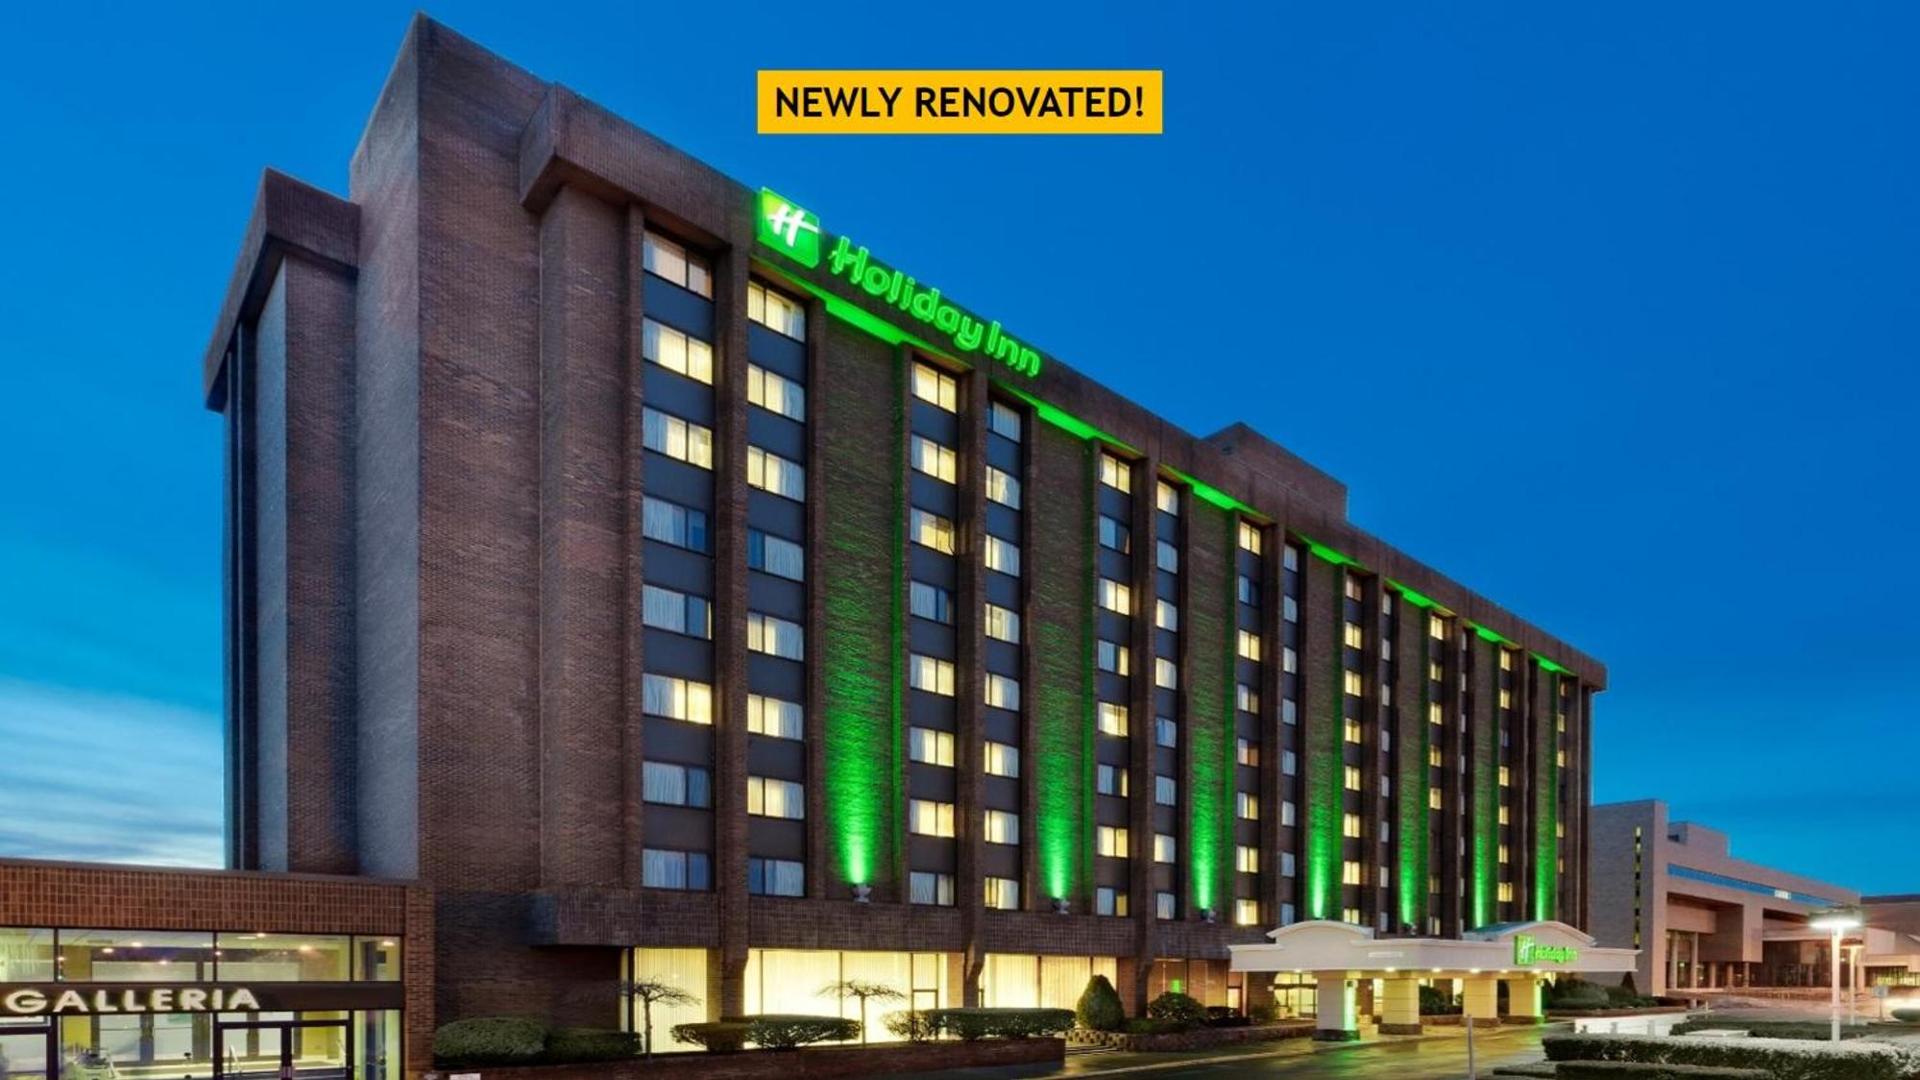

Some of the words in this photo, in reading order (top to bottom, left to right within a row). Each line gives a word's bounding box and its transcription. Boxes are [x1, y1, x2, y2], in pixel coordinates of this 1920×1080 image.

[829, 236, 984, 350] Holiday
[988, 321, 1041, 376] Inn
[6, 987, 259, 1013] GALLERIA
